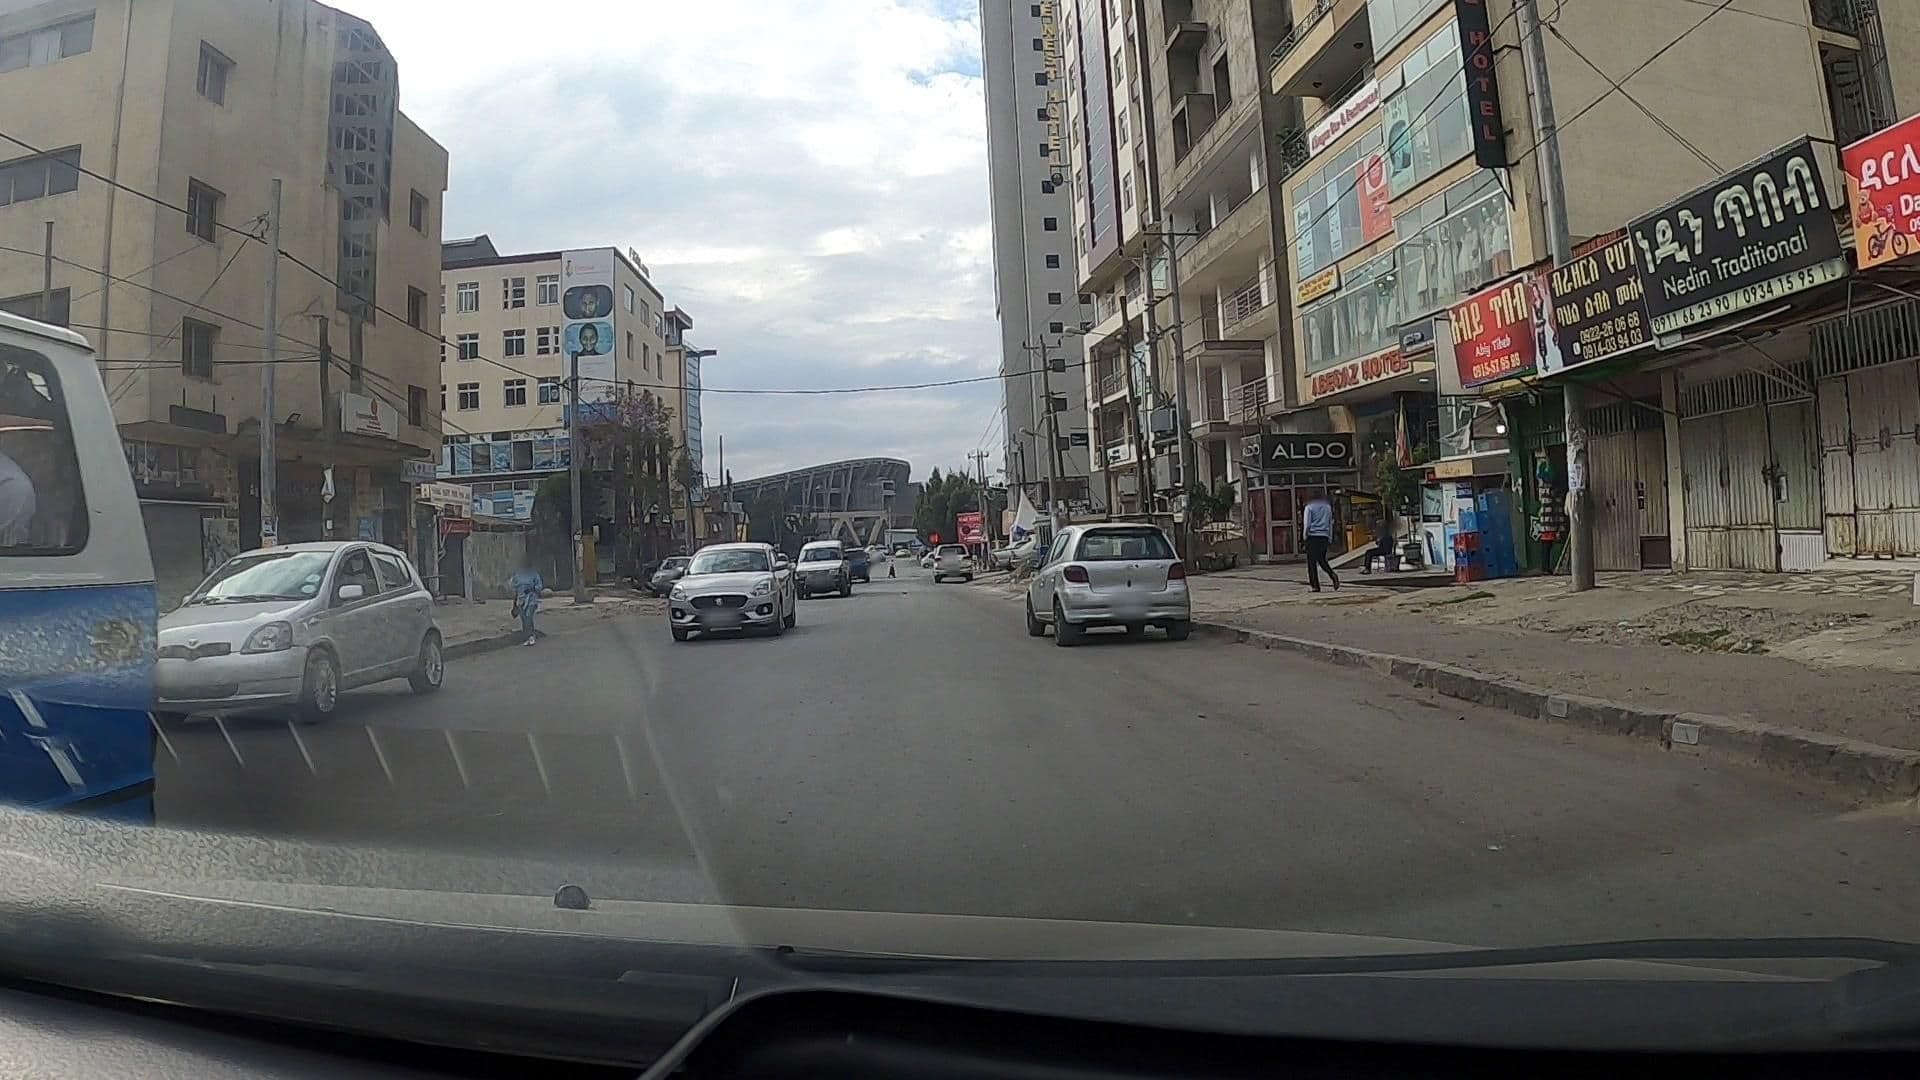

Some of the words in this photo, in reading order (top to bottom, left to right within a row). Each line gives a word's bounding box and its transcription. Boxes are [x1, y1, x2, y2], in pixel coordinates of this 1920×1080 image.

[1469, 31, 1497, 141] HOTEL
[1713, 156, 1820, 238] ጥበብ
[1662, 266, 1711, 300] Nedin
[1711, 224, 1809, 281] Traditional
[1627, 310, 1640, 327] 68
[1653, 311, 1679, 333] 0911
[1682, 307, 1696, 323] 66
[1699, 300, 1713, 318] 23
[1715, 295, 1731, 311] 90
[1743, 281, 1775, 303] 0934
[1777, 274, 1794, 293] 15
[1799, 267, 1816, 285] 95
[1617, 332, 1630, 349] 94
[1630, 328, 1643, 344] 03
[1360, 349, 1410, 380] HOTEL
[1271, 441, 1347, 460] ALDO
